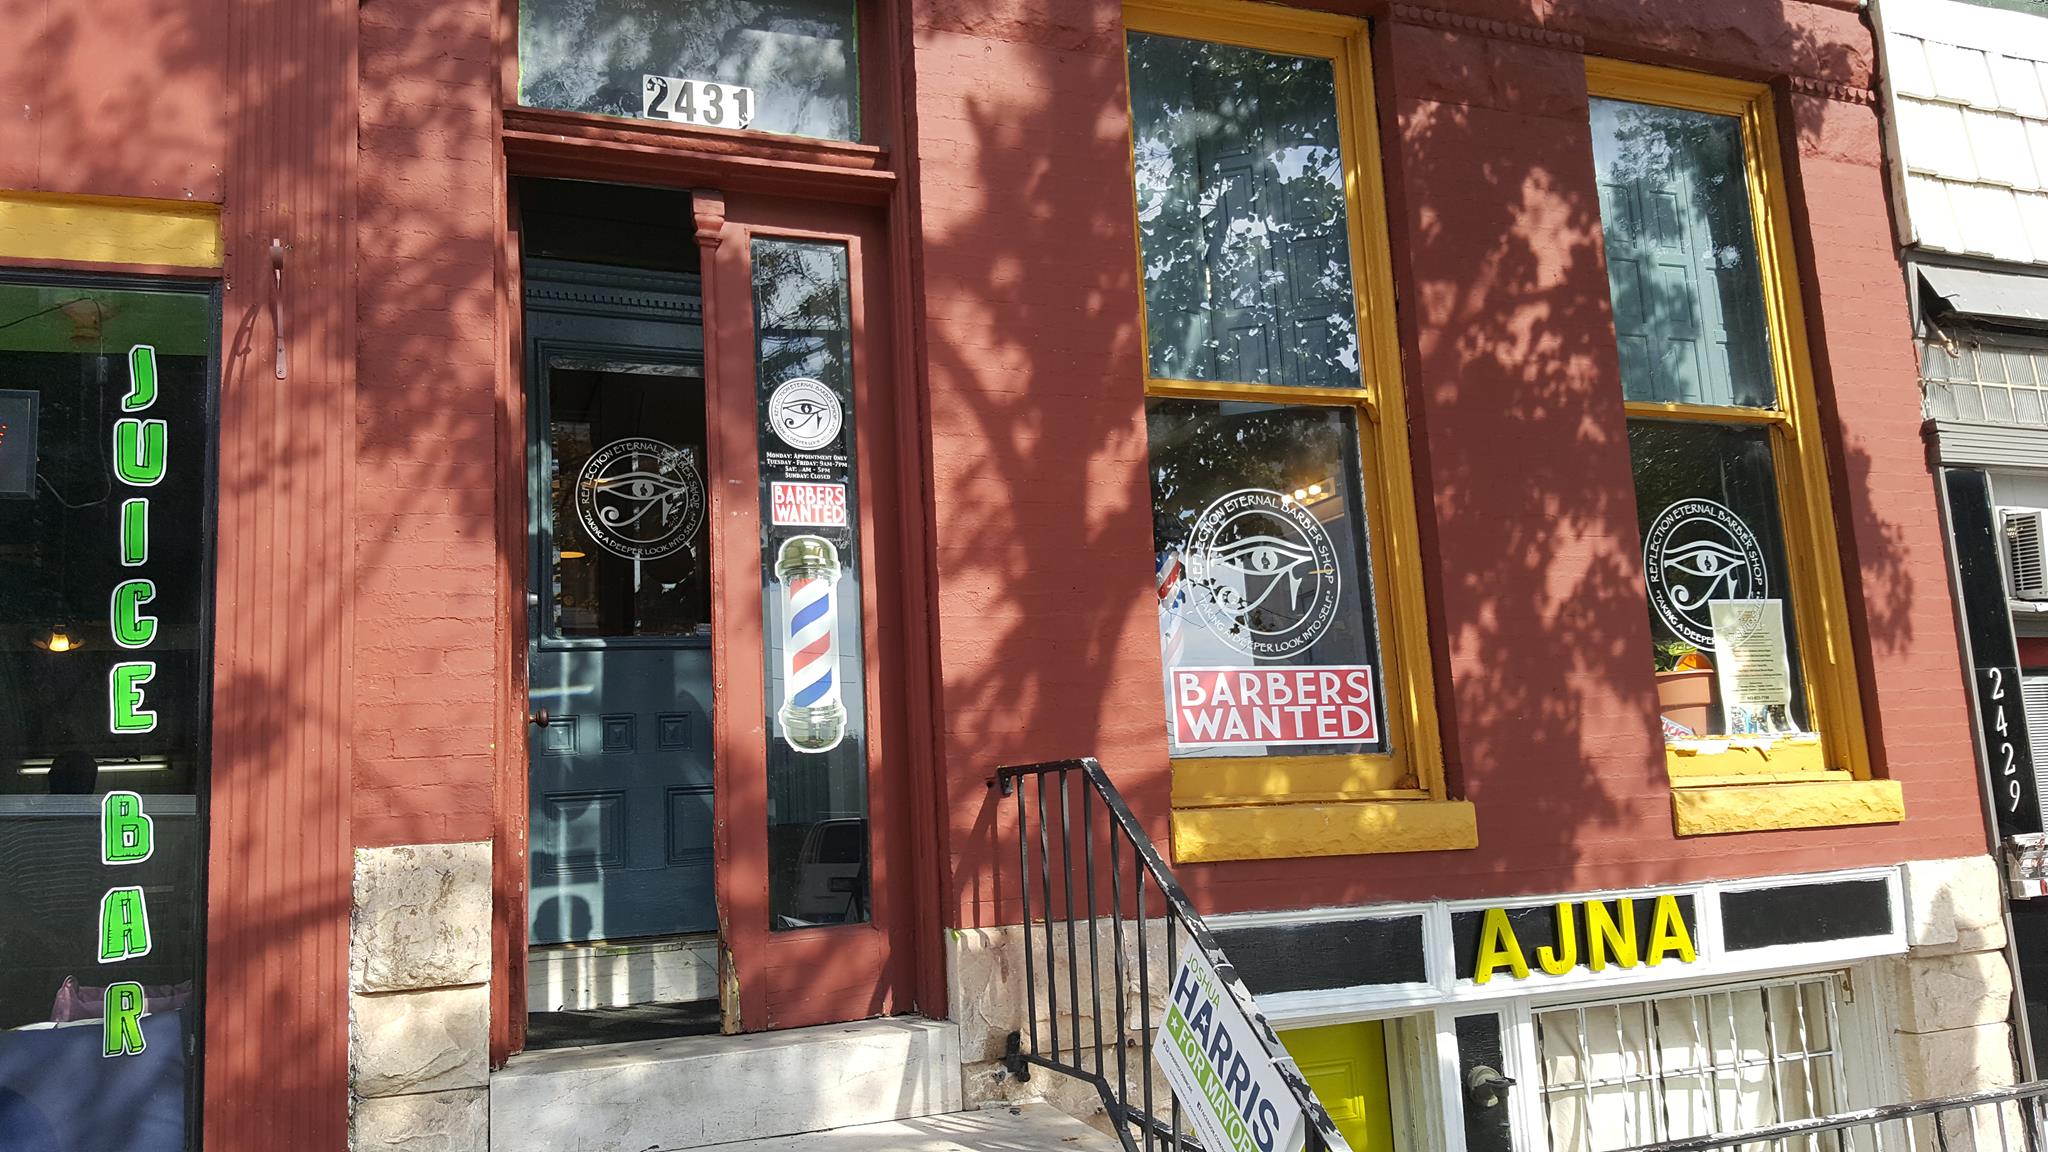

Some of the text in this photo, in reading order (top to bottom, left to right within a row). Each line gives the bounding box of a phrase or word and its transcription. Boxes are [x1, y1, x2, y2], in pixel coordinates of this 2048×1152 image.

[646, 77, 749, 129] 2431
[581, 449, 614, 504] REFLECTION
[613, 442, 658, 454] ETERNAL
[689, 481, 700, 509] SHOP
[774, 485, 844, 506] BARBERS
[775, 504, 845, 523] WANTED
[1224, 495, 1279, 513] ETERNAL
[1281, 502, 1322, 544] BARBER
[1318, 545, 1333, 584] SHOP
[604, 536, 613, 544] A
[609, 541, 643, 555] DEEPER
[645, 545, 669, 555] LOOK
[668, 534, 686, 549] INTO
[1650, 504, 1763, 586] REFLECTION ETERNAL BARBER SHOP
[1275, 637, 1304, 652] LOOK
[1302, 620, 1321, 640] INTO
[1676, 623, 1684, 633] A
[98, 344, 168, 1058] JUICE BAR
[1179, 671, 1369, 706] BARBERS
[1182, 705, 1370, 740] WANTED
[1989, 667, 2021, 812] 2429
[1474, 894, 1697, 984] AJNA
[1185, 952, 1221, 1011] JOSHUA
[1174, 964, 1280, 1152] HARRIS
[1178, 1025, 1205, 1080] FOR
